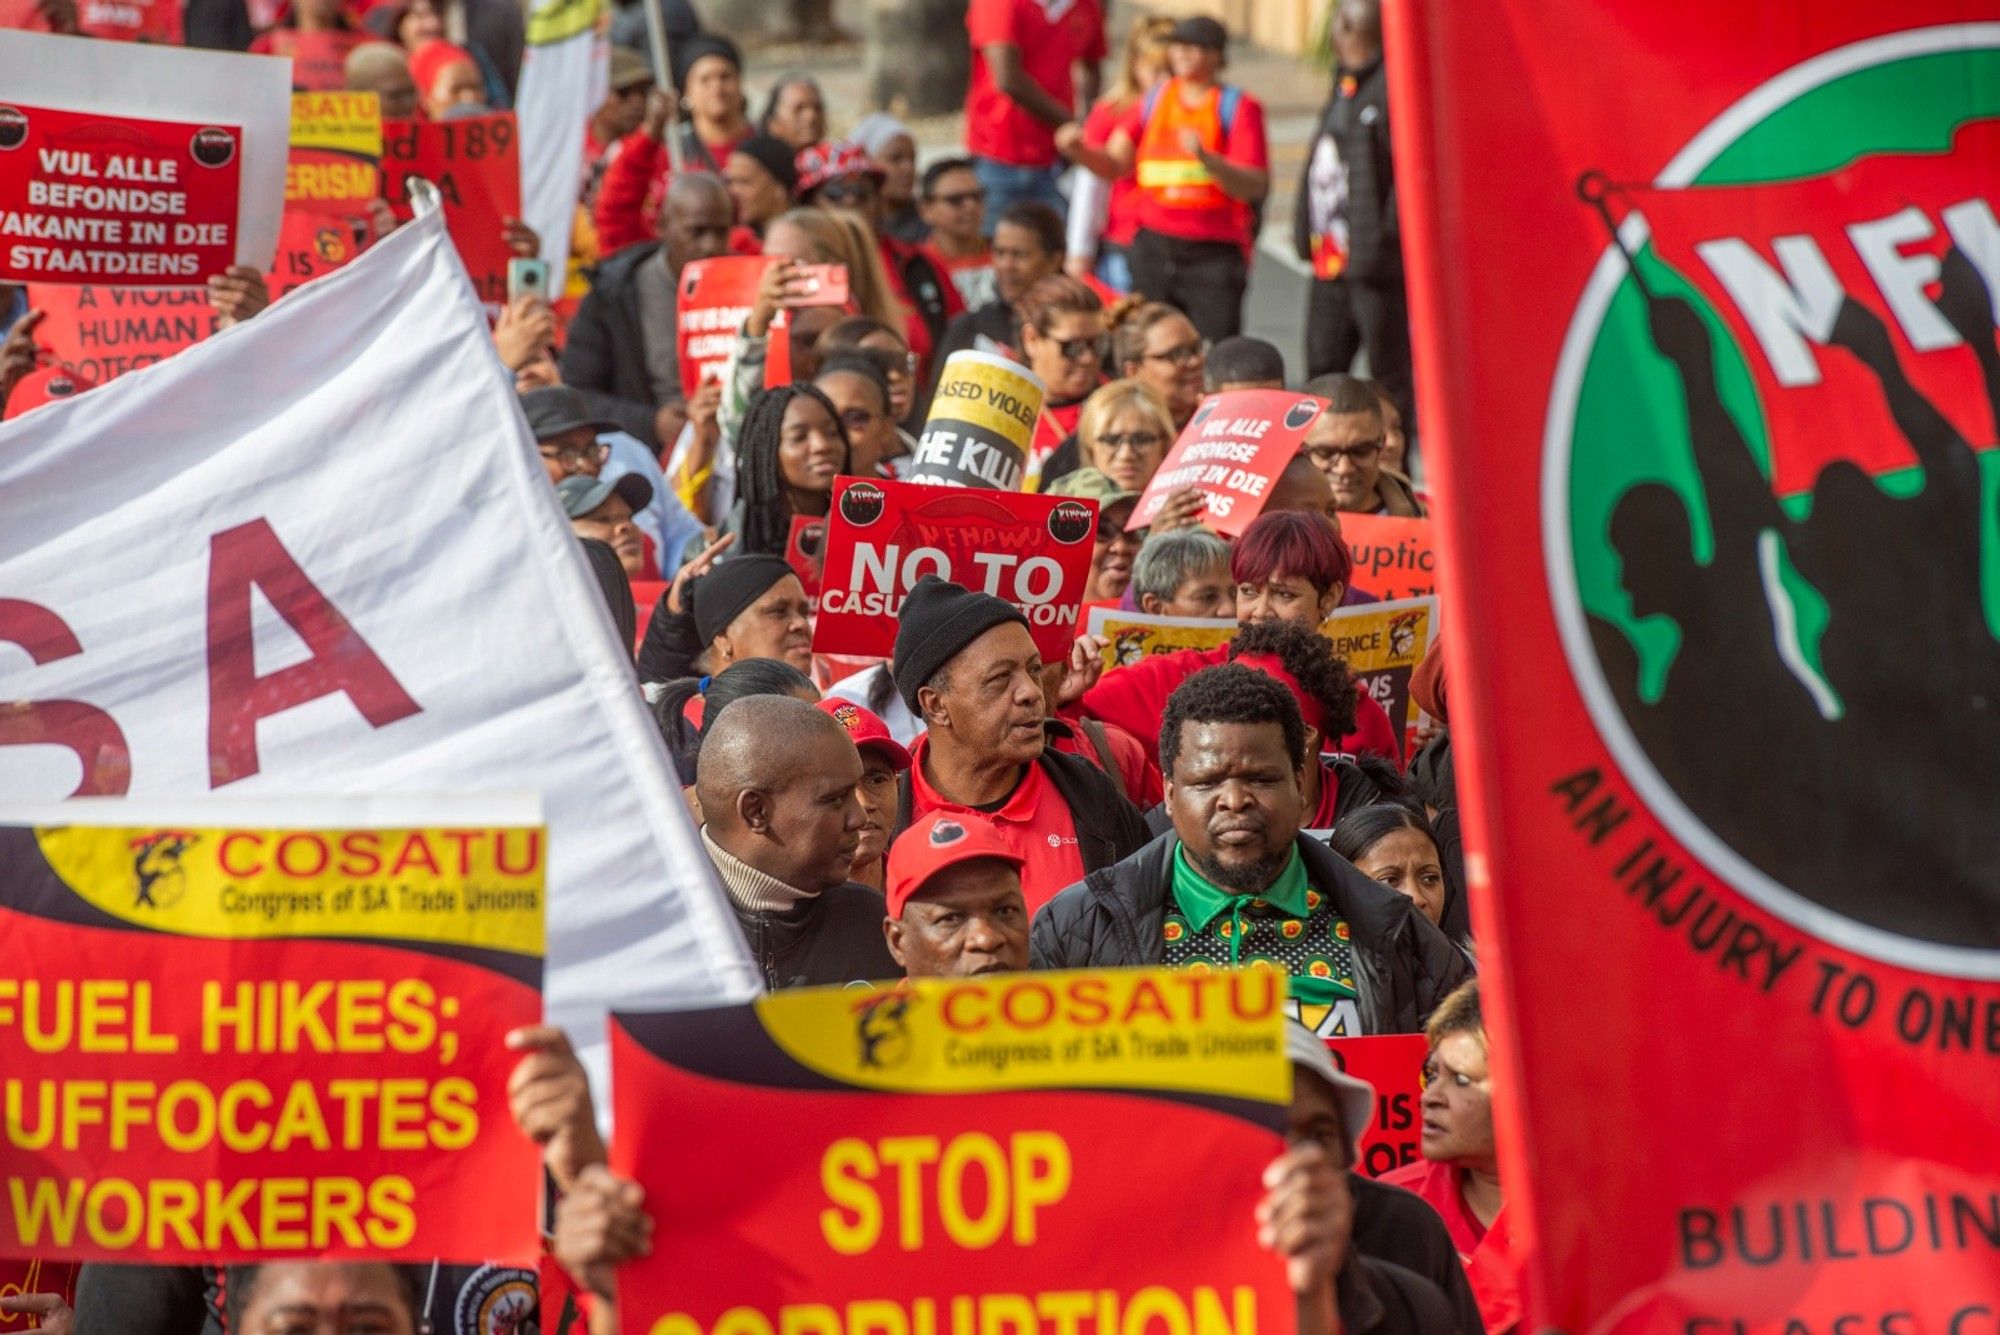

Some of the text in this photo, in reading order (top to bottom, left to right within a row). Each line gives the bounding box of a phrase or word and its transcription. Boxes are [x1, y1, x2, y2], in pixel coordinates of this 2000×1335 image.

[443, 116, 512, 161] 189
[39, 148, 178, 183] VUL ALLE
[28, 181, 187, 215] BEFONDSE
[129, 221, 165, 245] IN
[175, 223, 228, 246] DIE
[9, 245, 200, 276] STAATDIENS
[289, 251, 313, 276] IS
[79, 315, 198, 347] HUMAN
[1226, 470, 1268, 497] DIE
[850, 541, 1064, 605] NO TO
[217, 830, 541, 880] COSATU
[219, 884, 538, 919] Congress of SA Trade Unions
[1550, 764, 1631, 846] AN
[1611, 838, 1806, 994] INJURY
[1810, 958, 1878, 1029] TO
[202, 978, 459, 1064] HIKES;
[940, 973, 1277, 1032] COSATU
[945, 1031, 1277, 1071] Congress of SA Trade Unions
[4, 1077, 480, 1152] UFFOCATES
[1379, 1093, 1413, 1131] IS
[8, 1175, 418, 1251] WORKERS
[820, 1131, 1071, 1255] STOP
